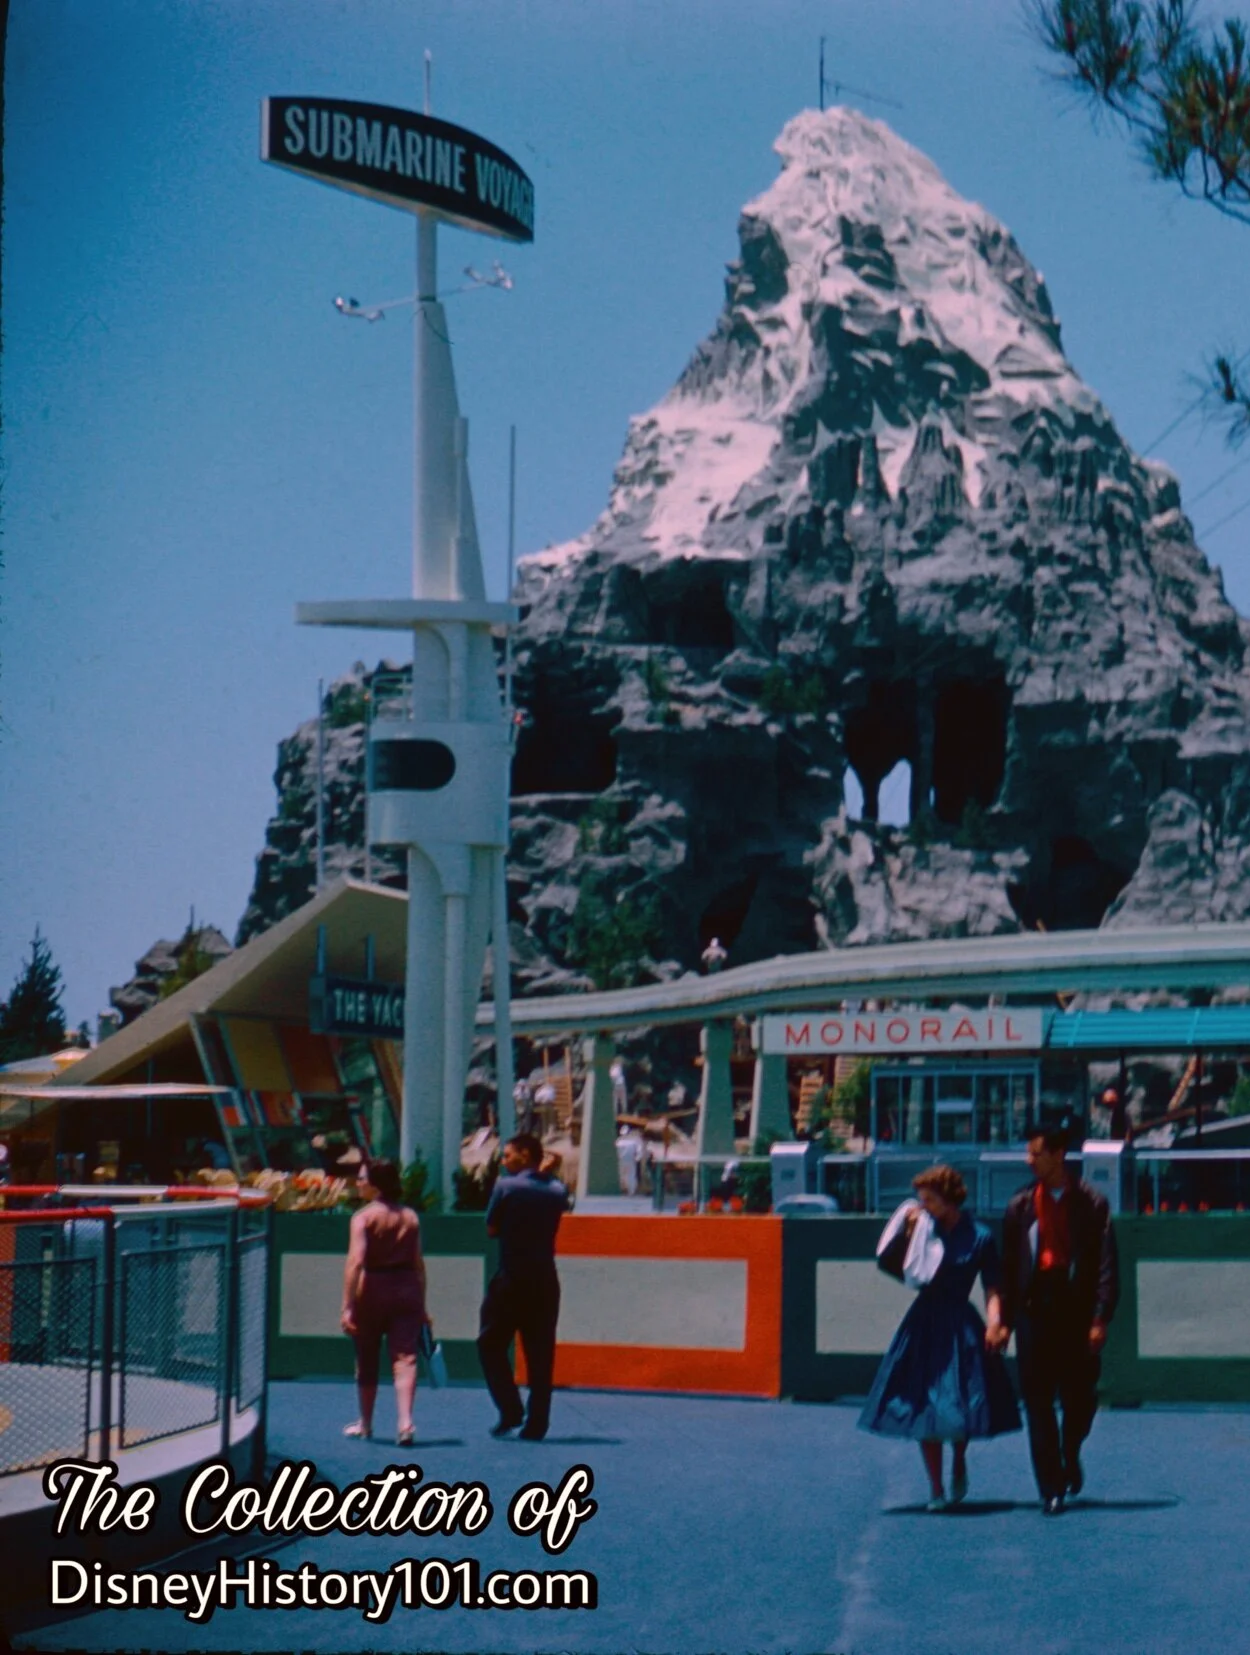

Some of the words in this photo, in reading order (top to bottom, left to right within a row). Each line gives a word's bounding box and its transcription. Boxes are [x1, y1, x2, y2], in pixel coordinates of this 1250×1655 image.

[284, 105, 466, 193] SUBMARINE
[333, 988, 366, 1024] THE
[785, 1017, 1022, 1046] MONORAIL
